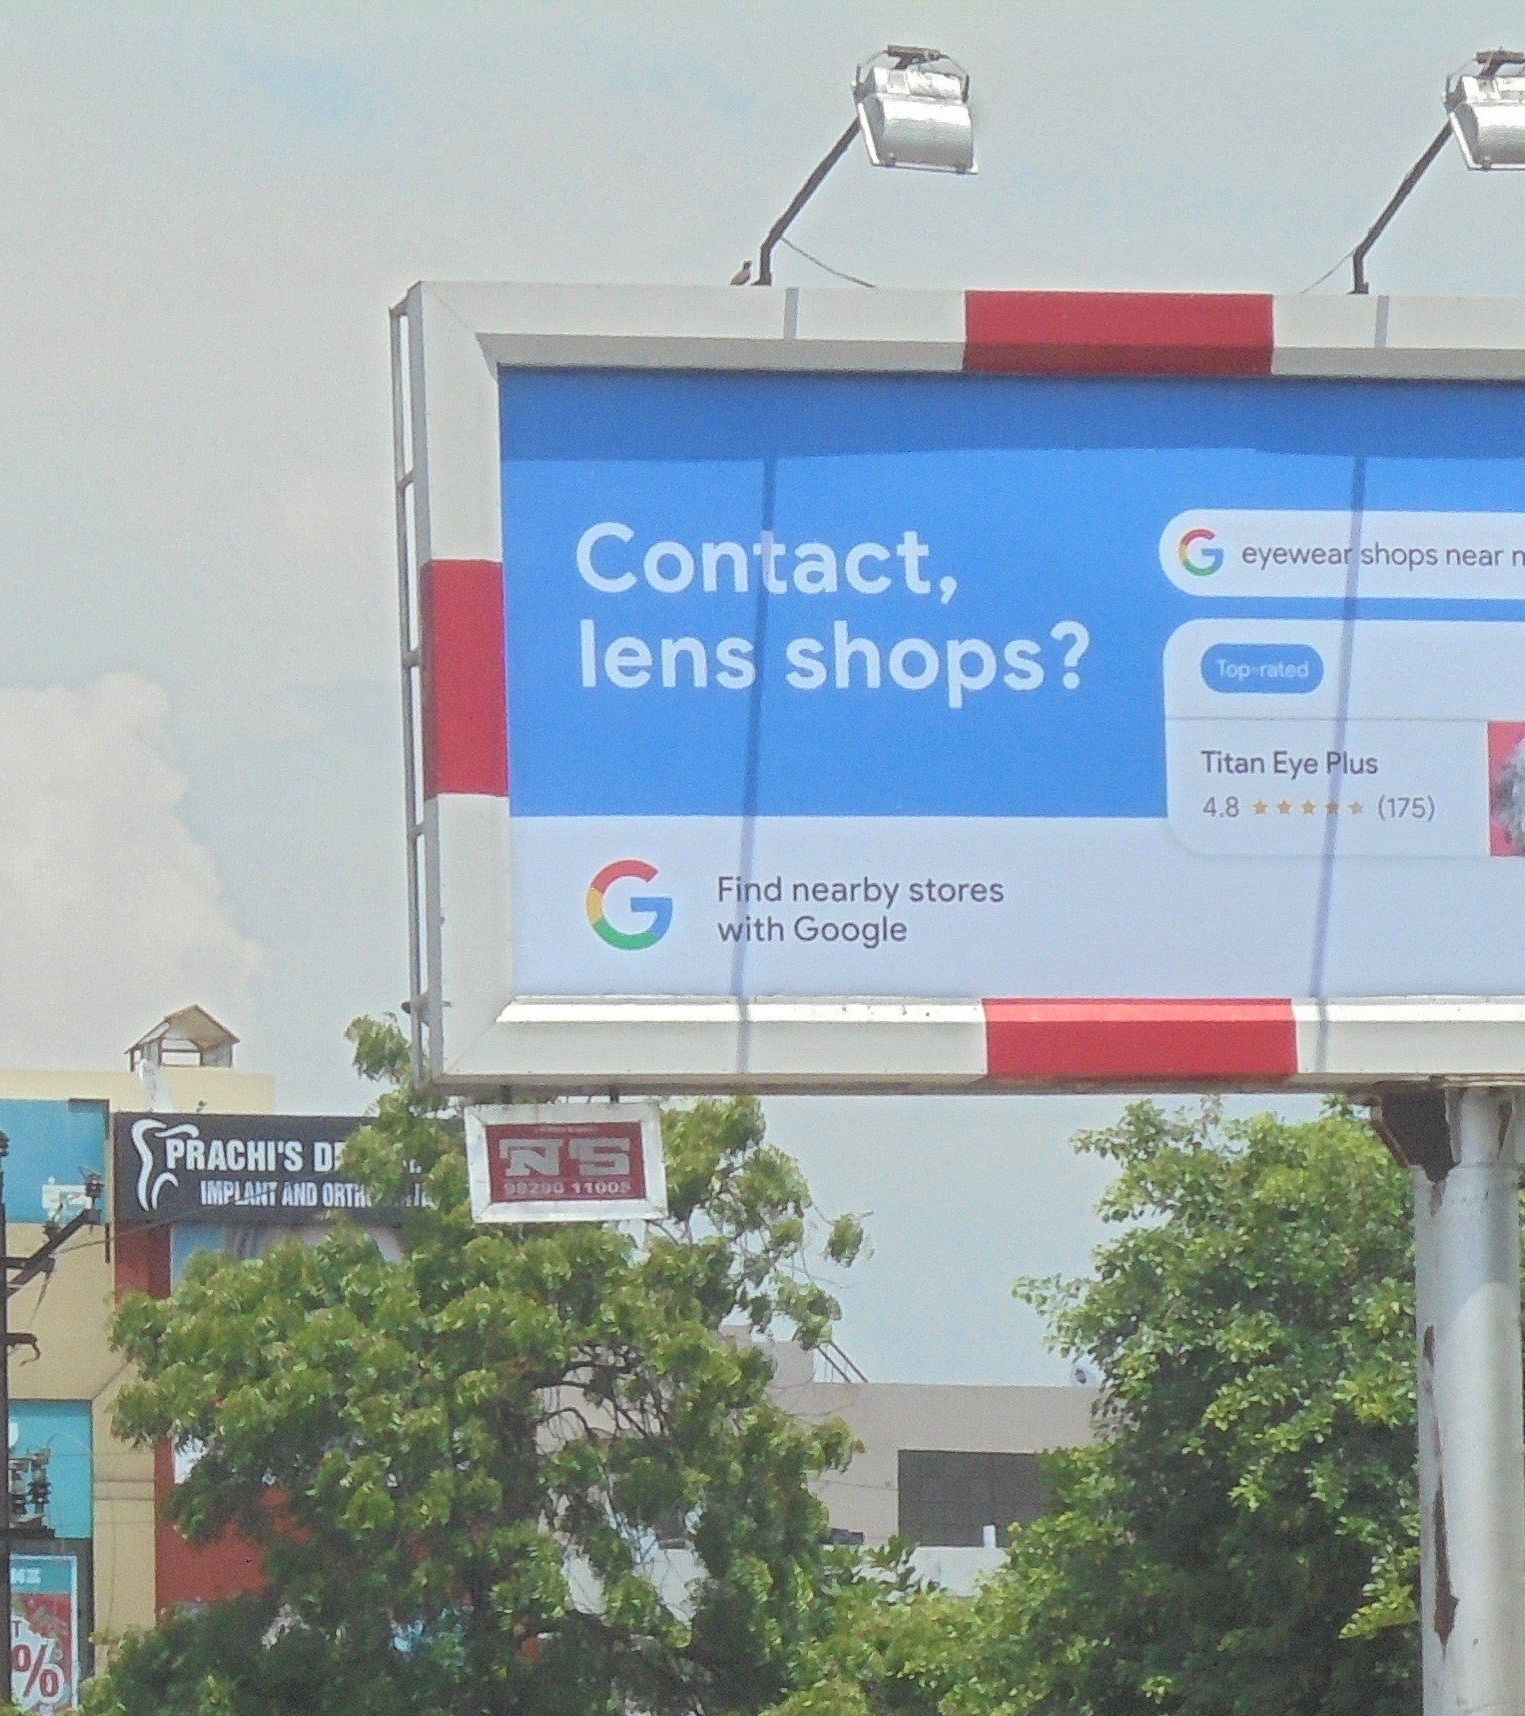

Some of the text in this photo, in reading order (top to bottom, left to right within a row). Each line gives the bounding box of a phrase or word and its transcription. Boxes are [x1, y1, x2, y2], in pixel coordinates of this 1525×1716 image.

[576, 521, 958, 604] Contact,
[1241, 545, 1352, 571] eyewear
[1360, 542, 1438, 572] shops
[1446, 547, 1502, 568] near
[579, 618, 1091, 710] lens shops?
[1215, 658, 1310, 682] Top-rated
[1201, 750, 1379, 779] Titan Eye Plus
[1202, 795, 1436, 821] 4.8 (175)
[717, 875, 1005, 910] Find nearby stores
[717, 916, 908, 950] with Google
[165, 1137, 305, 1172] PRACHI'S
[200, 1179, 373, 1208] IMPLANT AND ORTH
